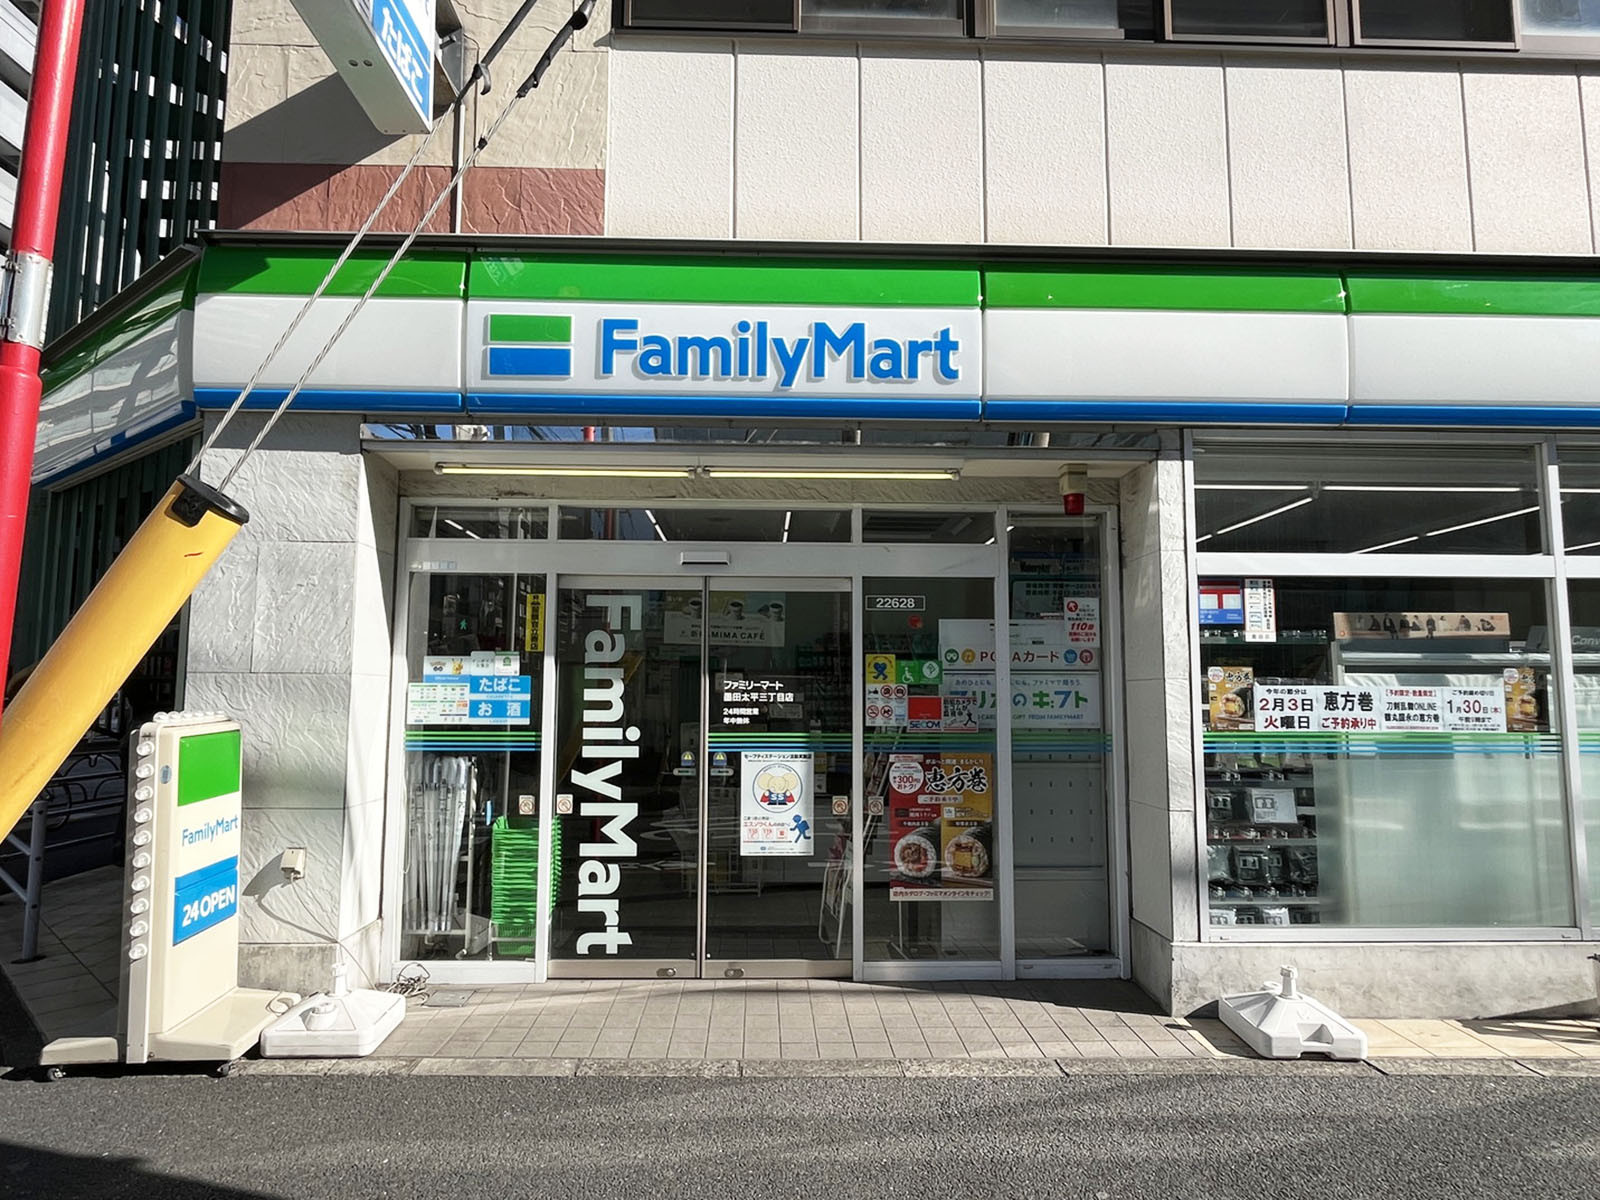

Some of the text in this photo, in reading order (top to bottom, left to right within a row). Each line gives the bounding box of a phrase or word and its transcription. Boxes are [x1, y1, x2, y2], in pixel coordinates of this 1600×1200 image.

[381, 7, 424, 105] たばこ
[602, 318, 959, 388] FamilyMart
[876, 598, 915, 608] 22628
[479, 677, 521, 692] たばこ
[723, 680, 784, 690] ファミリーマート
[1259, 698, 1313, 712] 2月3日
[1323, 691, 1373, 712] 恵方巻
[910, 721, 940, 729] SECOM
[1264, 715, 1310, 729] 火曜日
[1321, 717, 1376, 730] ご予約承り中
[571, 594, 643, 955] FamilyMart
[926, 767, 987, 792] 恵方巻
[182, 816, 238, 846] FamilyMart
[201, 884, 236, 917] OPEN
